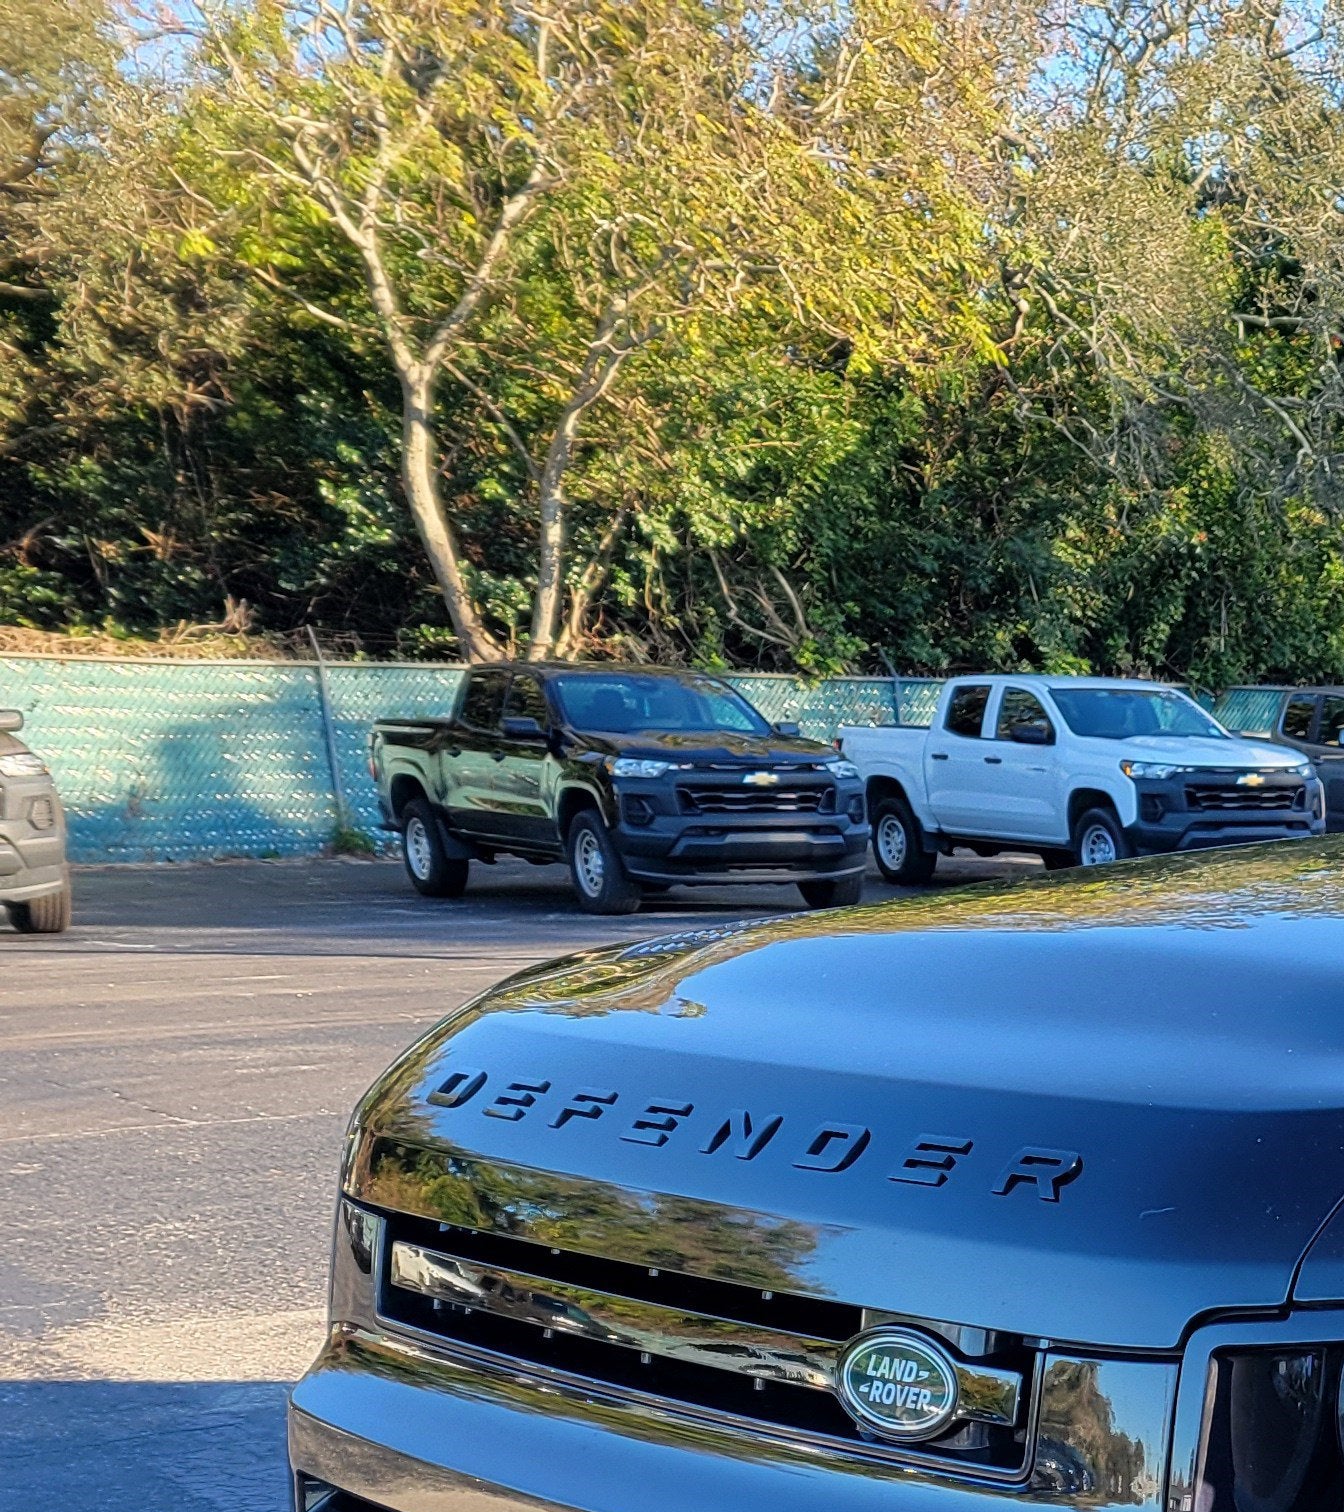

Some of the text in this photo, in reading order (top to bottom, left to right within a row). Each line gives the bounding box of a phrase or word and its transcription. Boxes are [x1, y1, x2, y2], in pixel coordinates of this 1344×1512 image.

[426, 1069, 1084, 1203] DEFENDER
[866, 1353, 919, 1383] LAND
[868, 1380, 932, 1411] ROVER
